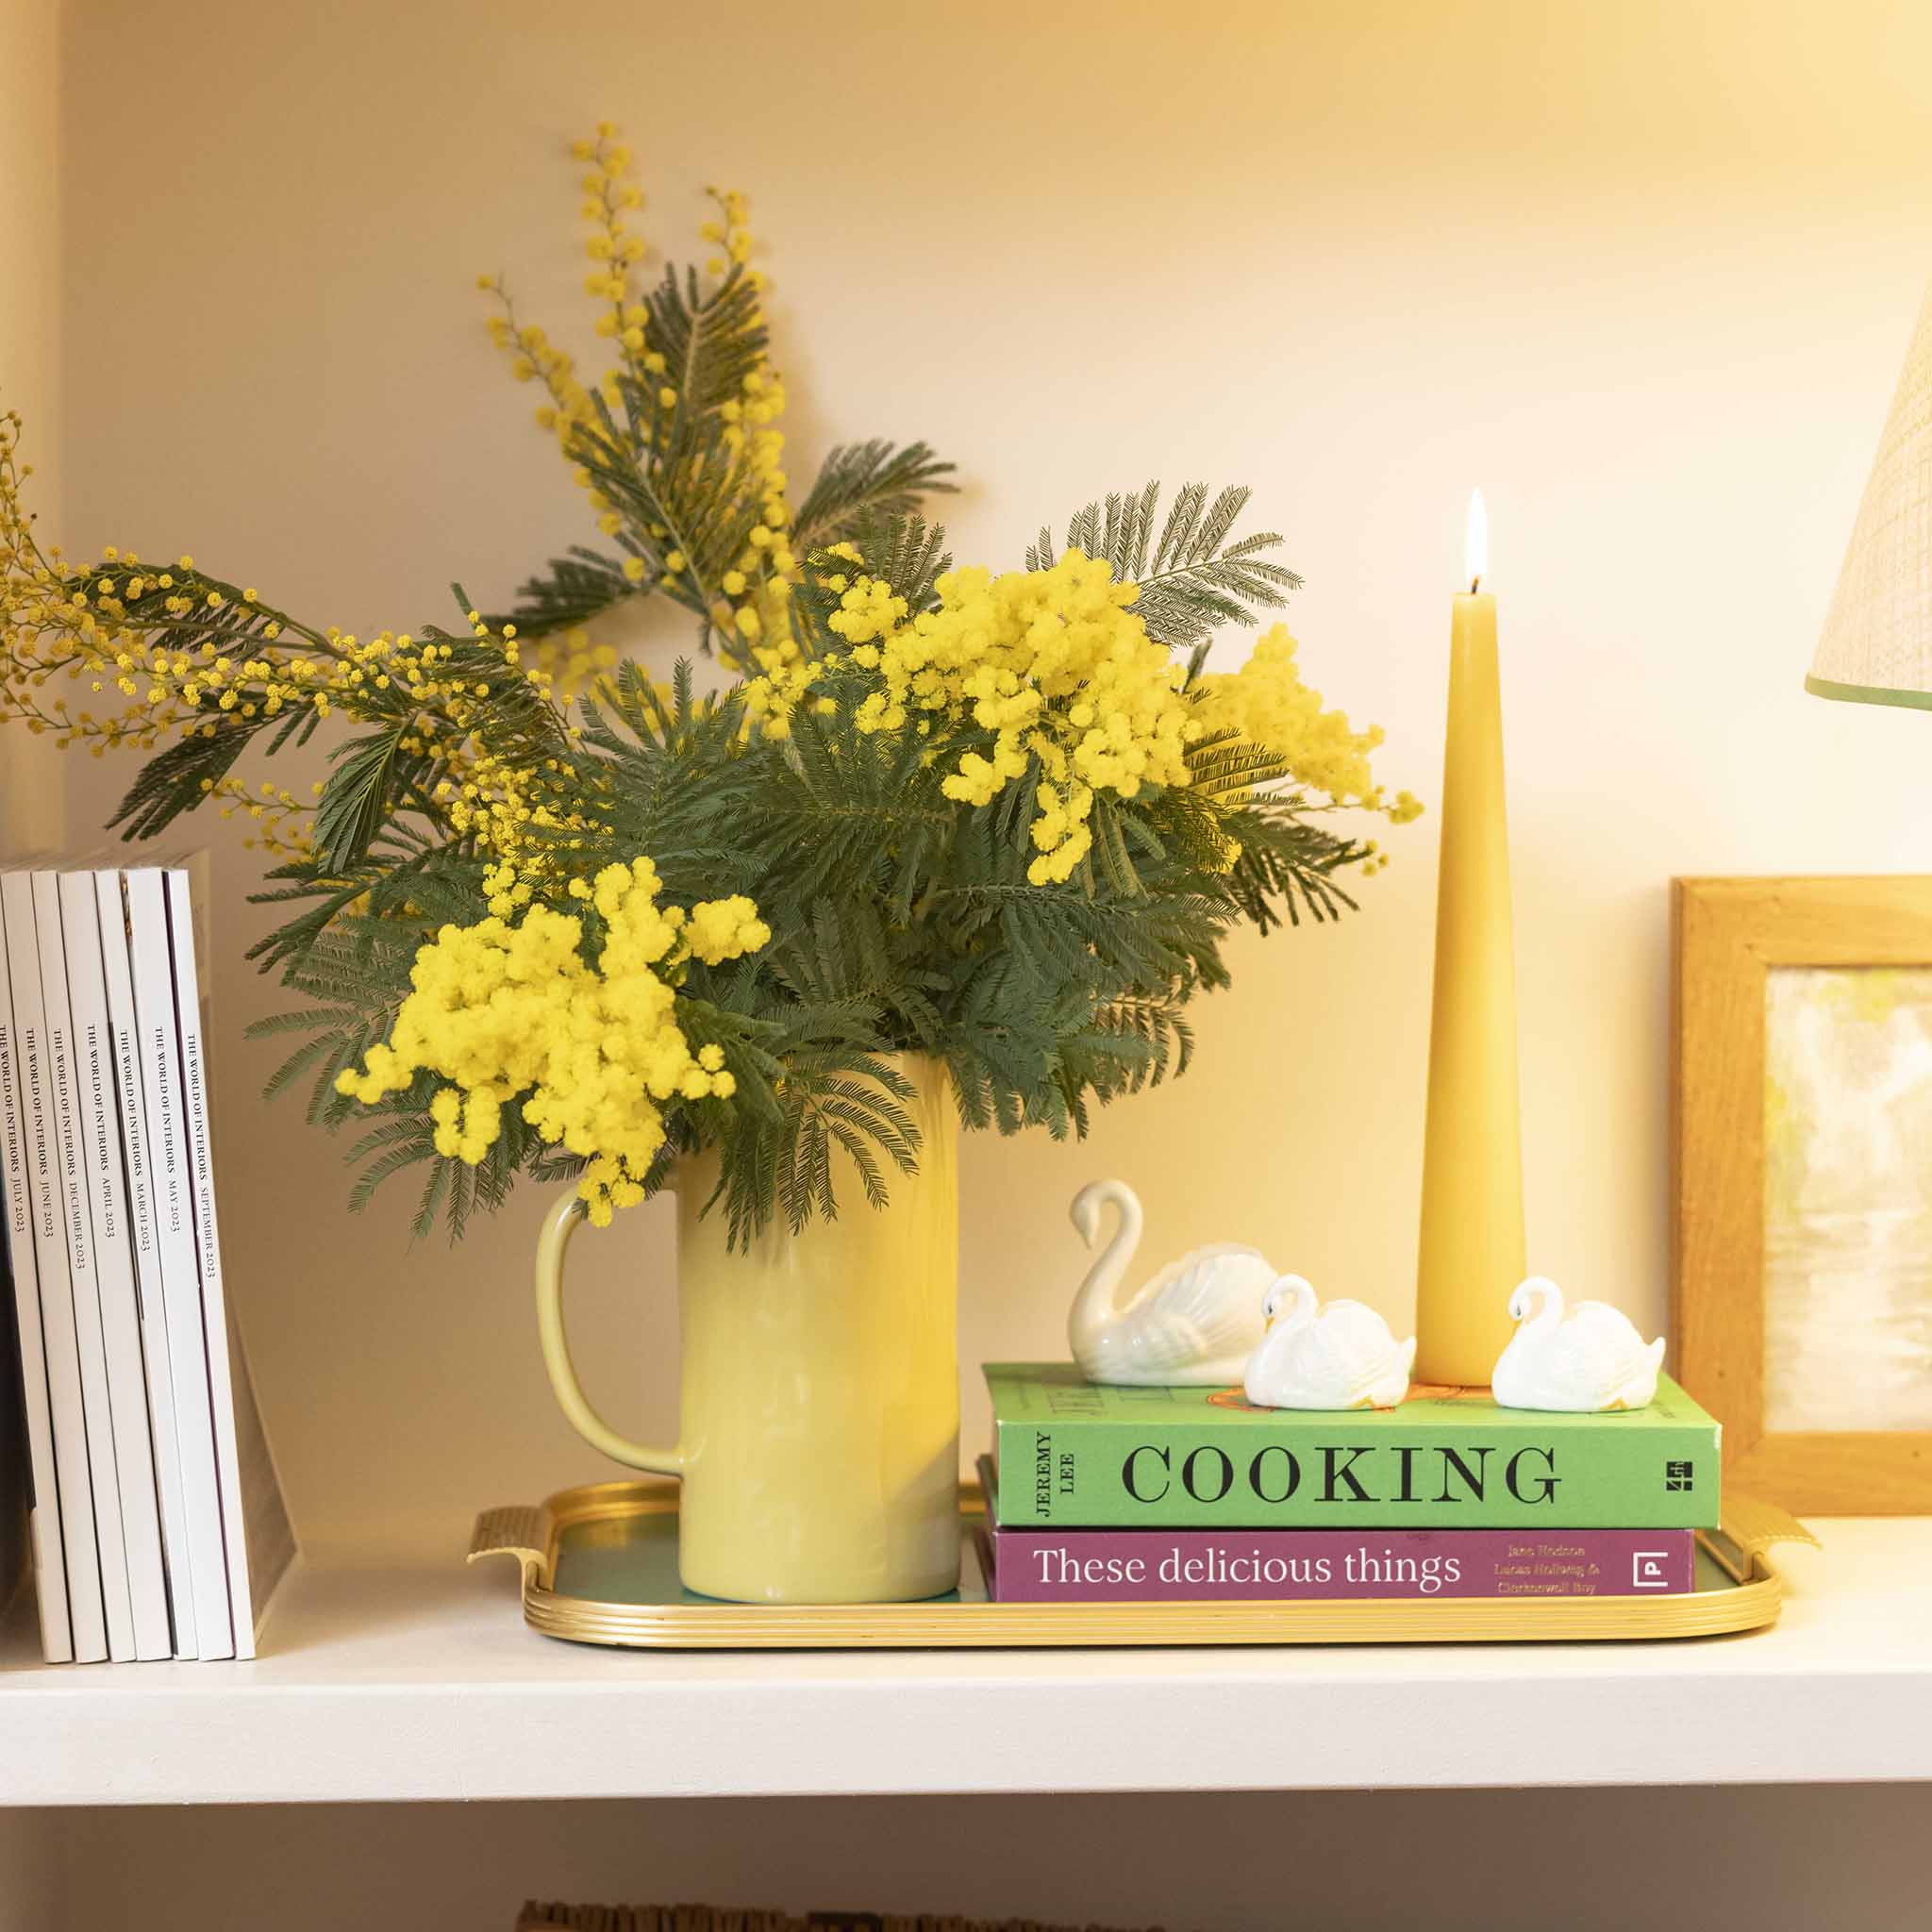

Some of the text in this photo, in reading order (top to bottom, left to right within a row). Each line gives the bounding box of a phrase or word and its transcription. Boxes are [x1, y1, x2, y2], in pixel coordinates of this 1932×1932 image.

[1, 1050, 11, 1092] WORLD
[5, 1095, 13, 1109] OF
[88, 1024, 114, 1238] THE WORLD OF INTERIORS APRIL 2023
[155, 1026, 180, 1232] THE WORLD OF INTERIORS MAY 2023
[7, 1112, 20, 1173] INTERIORS
[26, 1028, 53, 1238] THE WORLD OF INTERIORS JUNE 2023
[54, 1028, 85, 1269] THE WORLD OF INTERIORS DECEMBER 2023
[120, 1029, 150, 1252] THE WORLD OF INTERIORS MARCH 2023
[188, 1034, 215, 1278] THE WORLD OF INTERIORS SEPTEMBER 2023
[10, 1177, 23, 1204] JULY
[15, 1208, 25, 1233] 2023
[1036, 1431, 1051, 1517] JEREMY
[1059, 1453, 1074, 1494] LEE
[1122, 1446, 1562, 1505] COOKING
[1033, 1548, 1461, 1593] These delicious things
